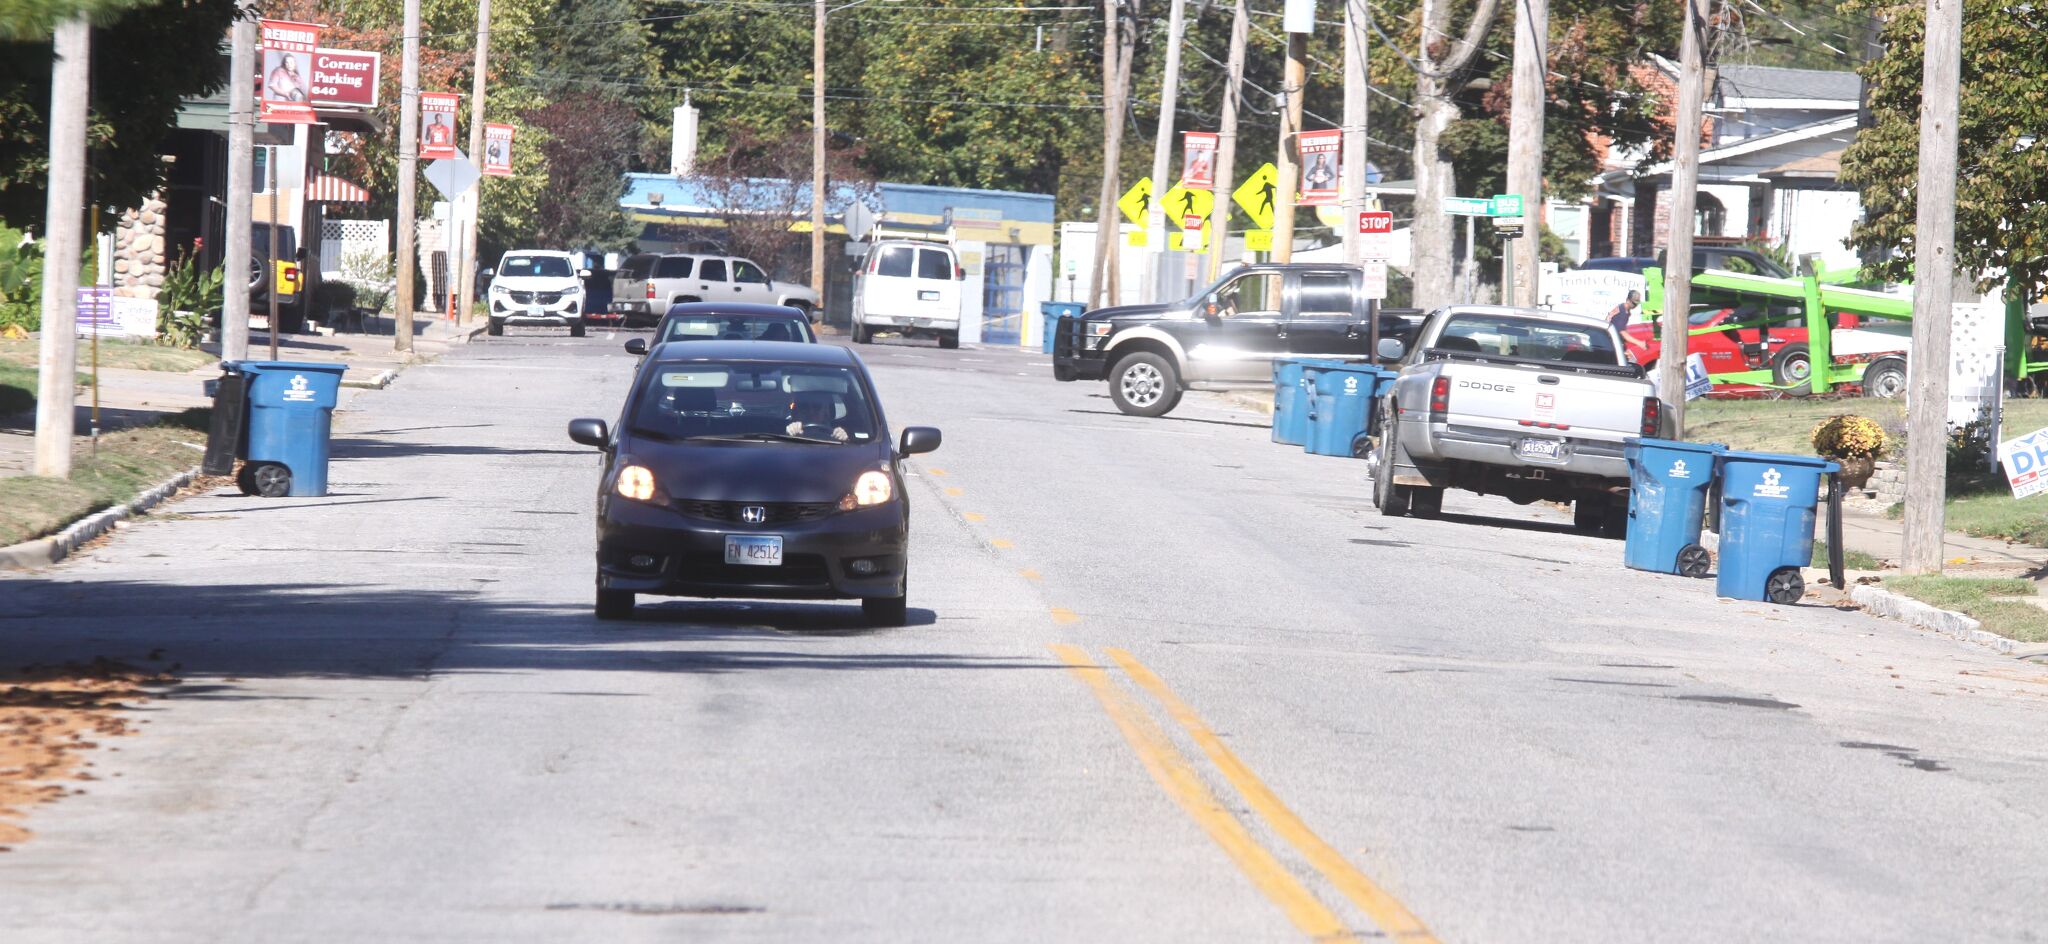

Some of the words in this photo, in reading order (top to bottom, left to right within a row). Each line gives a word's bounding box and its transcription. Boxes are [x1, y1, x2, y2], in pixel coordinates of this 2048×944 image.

[264, 28, 314, 43] REDBIRD
[318, 56, 370, 71] Corner
[314, 71, 363, 88] Parking
[311, 86, 338, 96] 640
[1497, 198, 1519, 207] BUS
[1360, 217, 1390, 230] STOP
[1558, 276, 1598, 288] Trinity
[1602, 275, 1641, 290] Chape
[1459, 380, 1516, 393] DODGE
[747, 544, 779, 560] 42512
